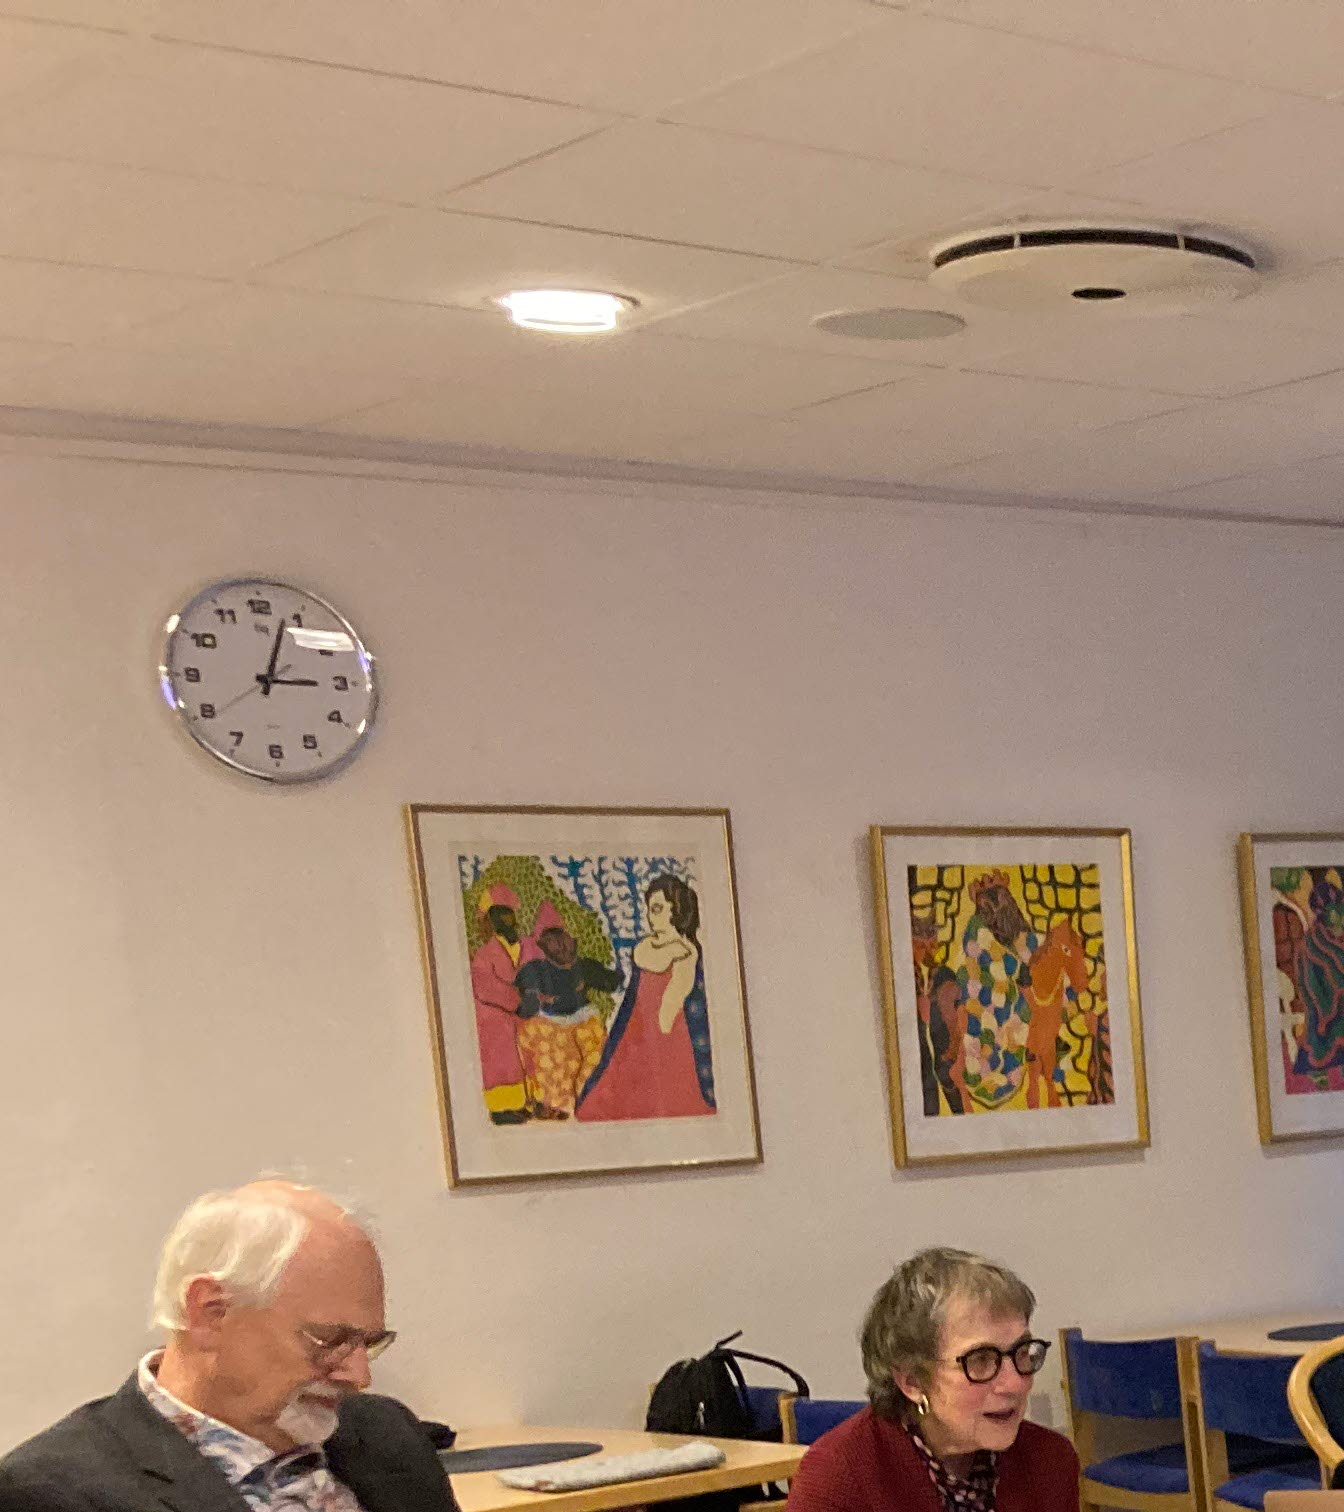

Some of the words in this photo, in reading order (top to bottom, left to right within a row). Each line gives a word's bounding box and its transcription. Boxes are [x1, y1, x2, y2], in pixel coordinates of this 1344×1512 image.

[246, 599, 272, 615] 12
[214, 608, 237, 624] 11
[292, 613, 303, 628] 1
[190, 633, 217, 649] 10
[184, 667, 200, 682] 9
[332, 676, 348, 691] 3
[200, 704, 215, 718] 8
[327, 710, 343, 723] 4
[229, 731, 243, 746] 7
[303, 734, 317, 749] 5
[268, 744, 283, 759] 6
